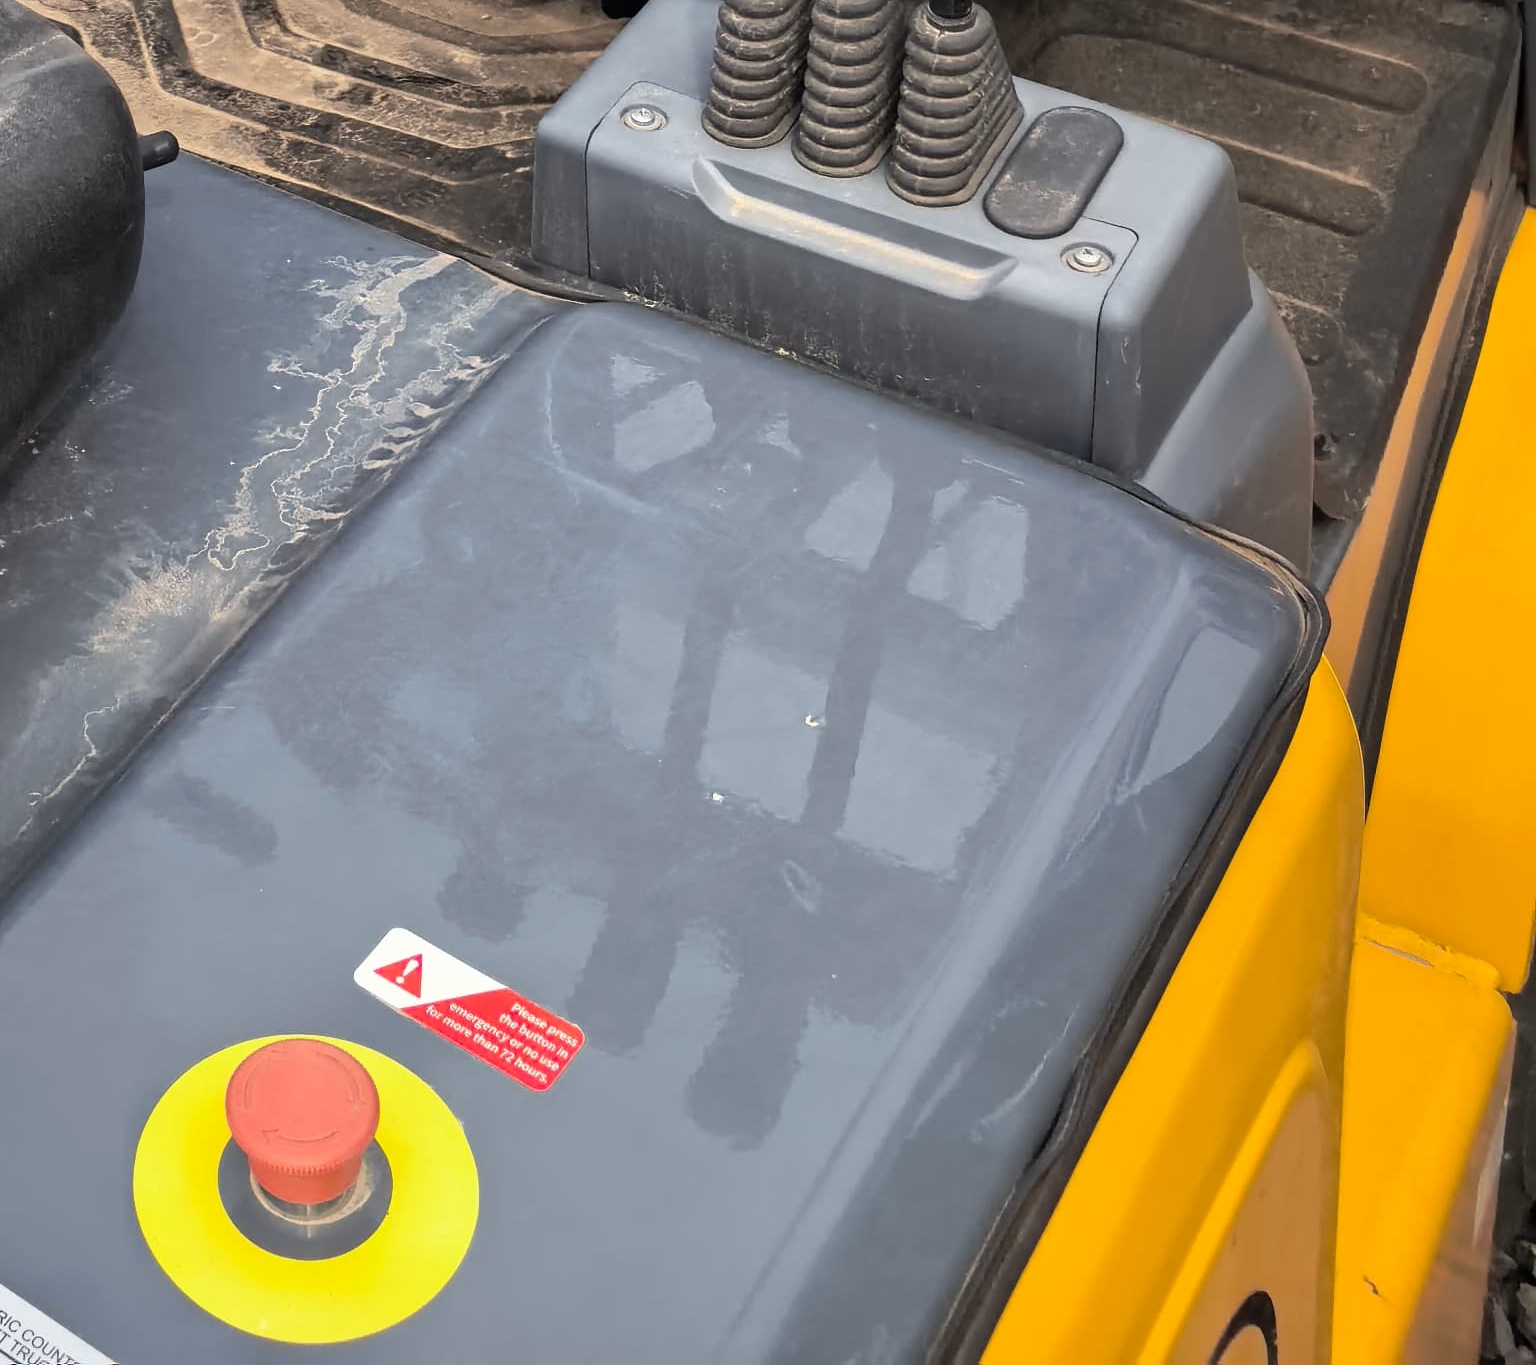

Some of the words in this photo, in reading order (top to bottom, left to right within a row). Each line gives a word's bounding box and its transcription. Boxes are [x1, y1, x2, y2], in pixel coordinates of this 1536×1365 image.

[425, 1004, 443, 1020] for
[442, 1016, 473, 1038] more
[473, 1033, 500, 1054] than
[499, 1048, 516, 1063] 72
[514, 1056, 548, 1084] hours.
[449, 1002, 510, 1043] emergency
[510, 1036, 524, 1049] or
[523, 1046, 539, 1059] no
[539, 1055, 560, 1072] use
[499, 1013, 519, 1030] the
[519, 1024, 556, 1052] button
[557, 1046, 569, 1059] in
[511, 1002, 548, 1030] Please
[546, 1025, 579, 1047] press
